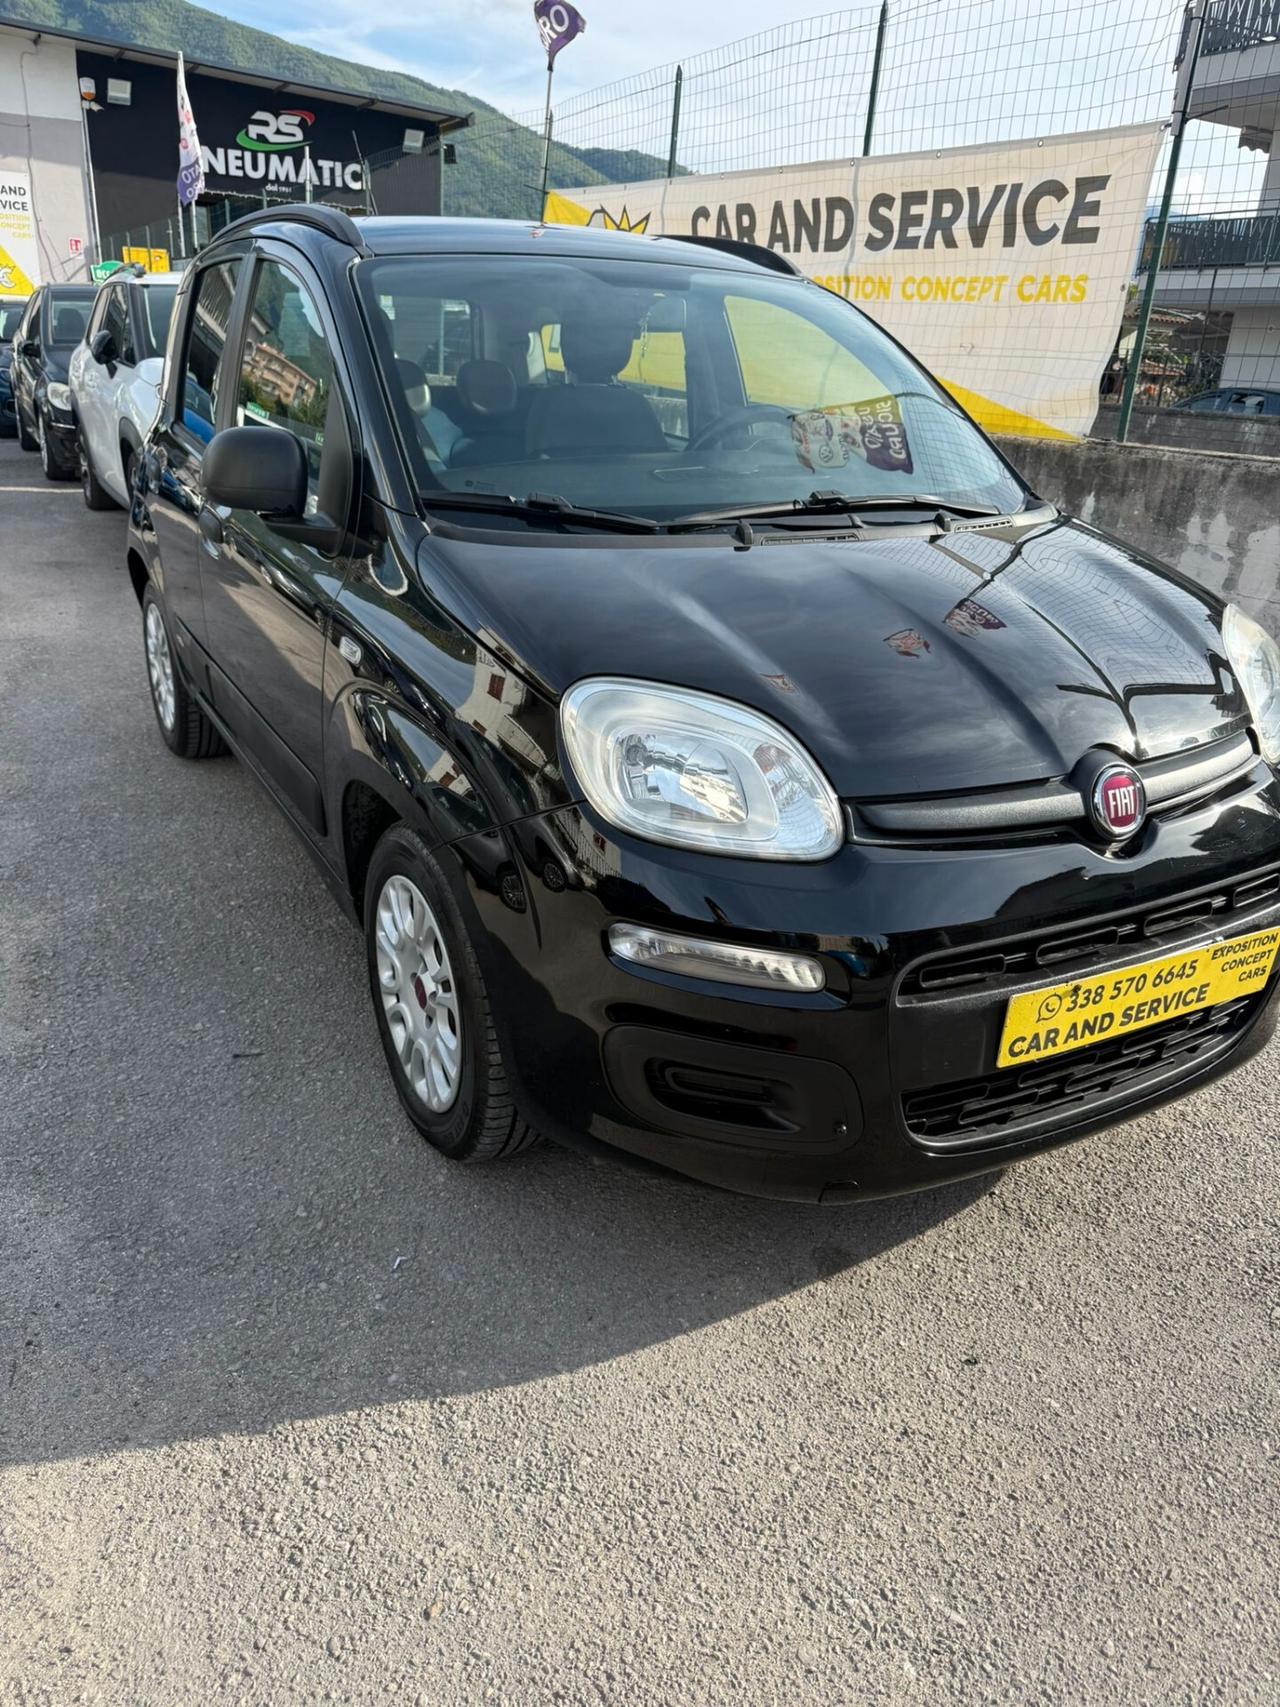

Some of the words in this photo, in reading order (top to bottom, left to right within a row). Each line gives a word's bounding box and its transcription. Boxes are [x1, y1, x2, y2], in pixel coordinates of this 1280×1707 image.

[248, 111, 304, 143] RS
[200, 145, 366, 191] NEUMATIC
[0, 185, 26, 196] AND
[691, 203, 757, 244] CAR
[767, 196, 854, 253] AND
[864, 174, 1112, 252] SERVICE
[901, 274, 1009, 302] CONCEPT
[1016, 273, 1089, 304] CARS
[1107, 786, 1134, 819] FIAT
[1211, 932, 1278, 960] EXPOSITION
[1221, 949, 1273, 972] CONCEPT
[1066, 985, 1103, 1012] 338
[1110, 972, 1147, 1001] 570
[1152, 959, 1199, 988] 6645
[1238, 965, 1267, 982] CARS
[1008, 1029, 1058, 1058] CAR
[1064, 1013, 1114, 1043] AND
[1119, 982, 1210, 1027] SERVICE
